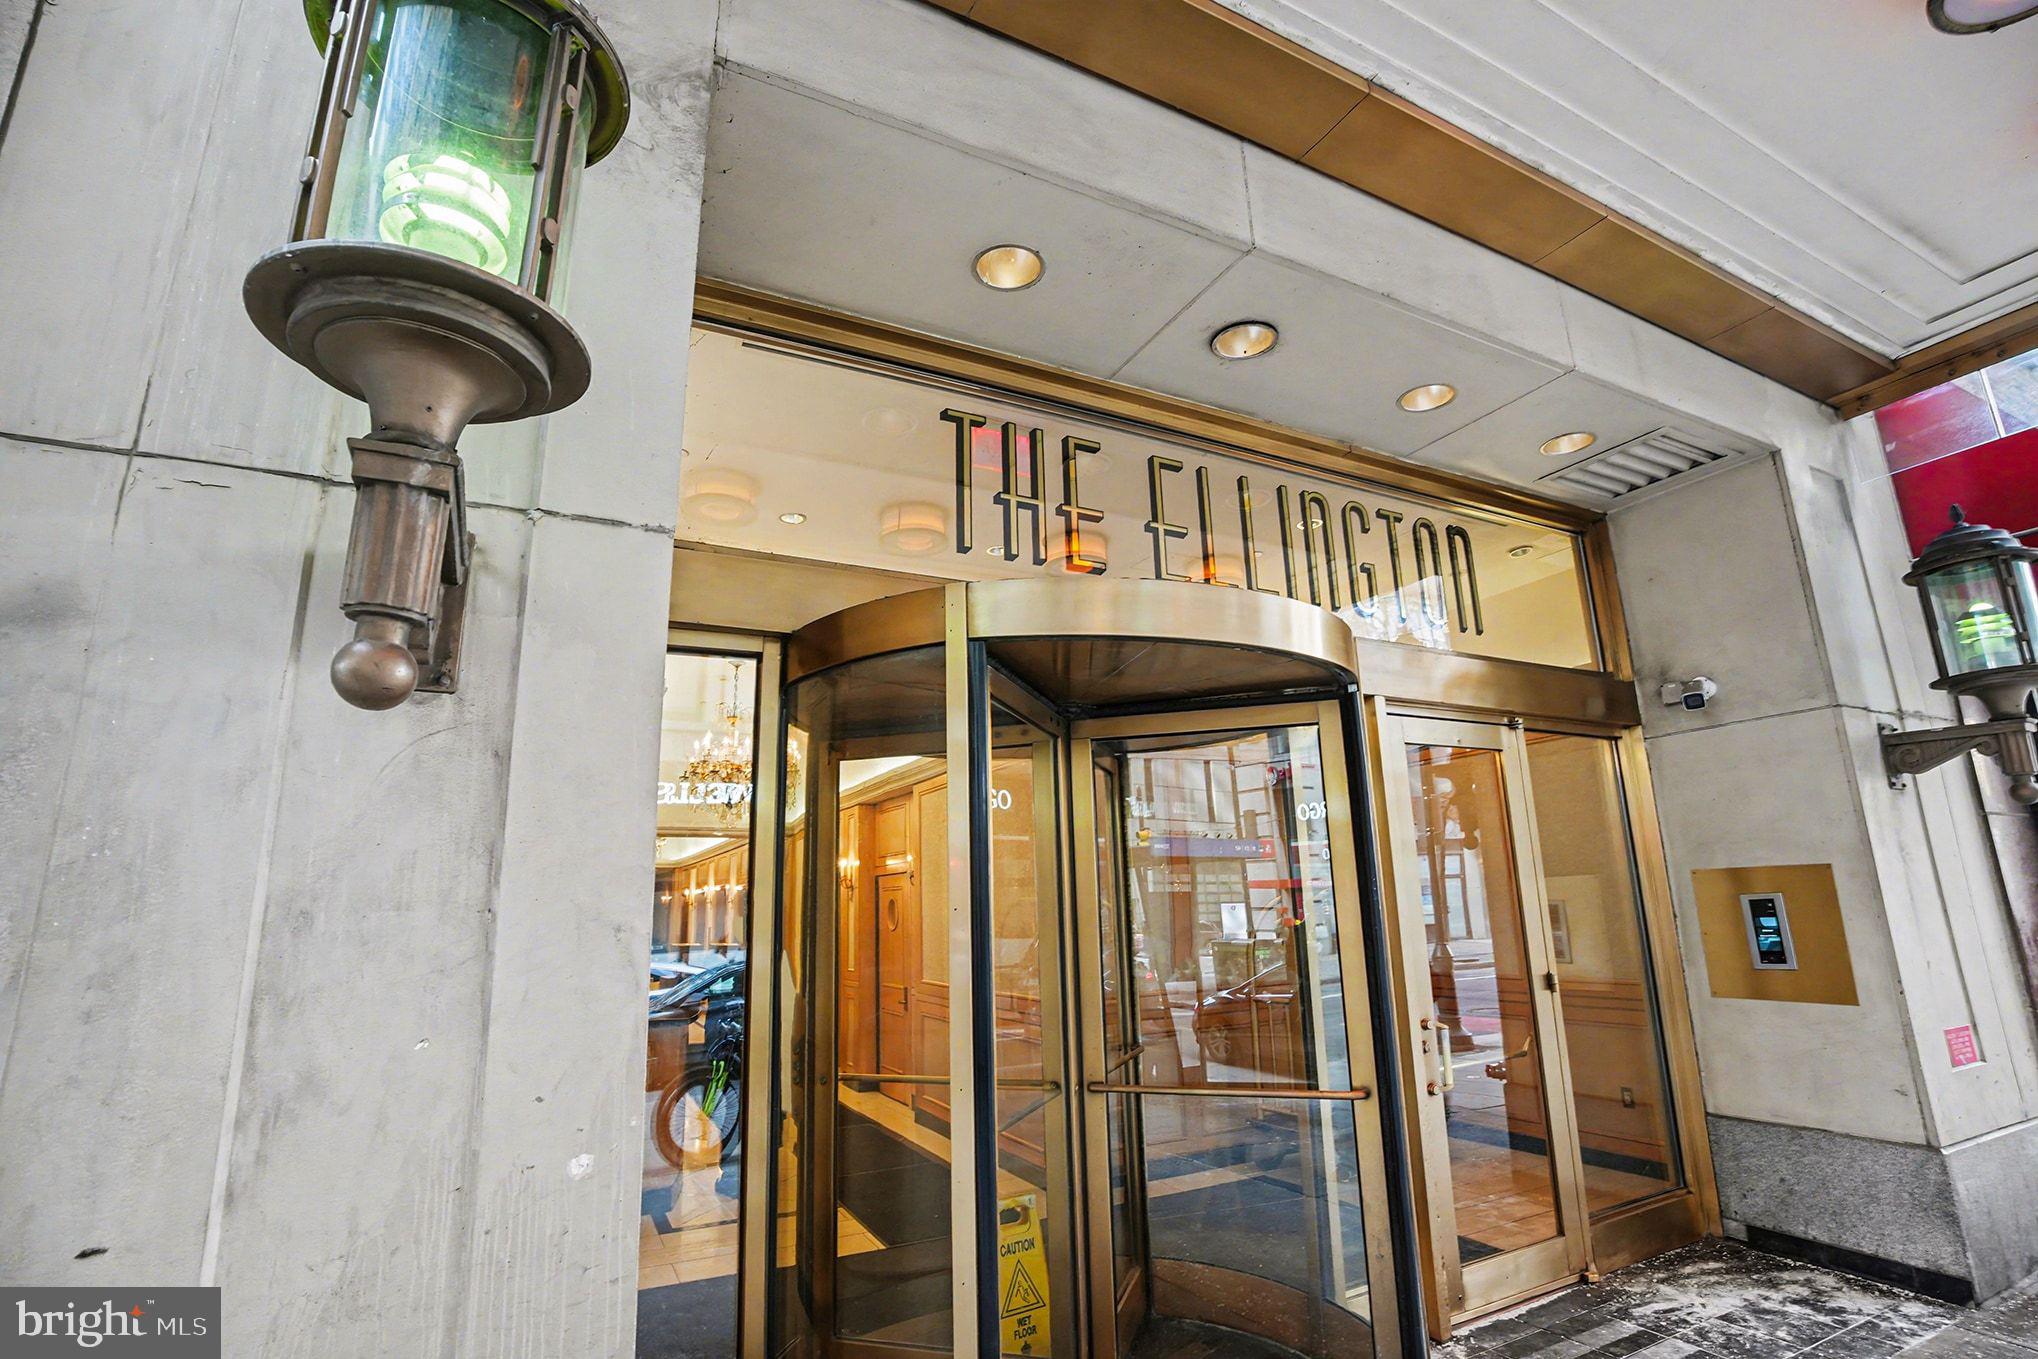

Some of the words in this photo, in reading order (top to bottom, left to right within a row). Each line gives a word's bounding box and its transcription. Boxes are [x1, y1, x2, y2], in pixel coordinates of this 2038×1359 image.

[940, 408, 1107, 576] THE
[1144, 455, 1483, 636] ELLINGTON
[1000, 1237, 1036, 1257] CAUTION
[1017, 1315, 1032, 1327] WET
[1014, 1325, 1037, 1341] FLOOR
